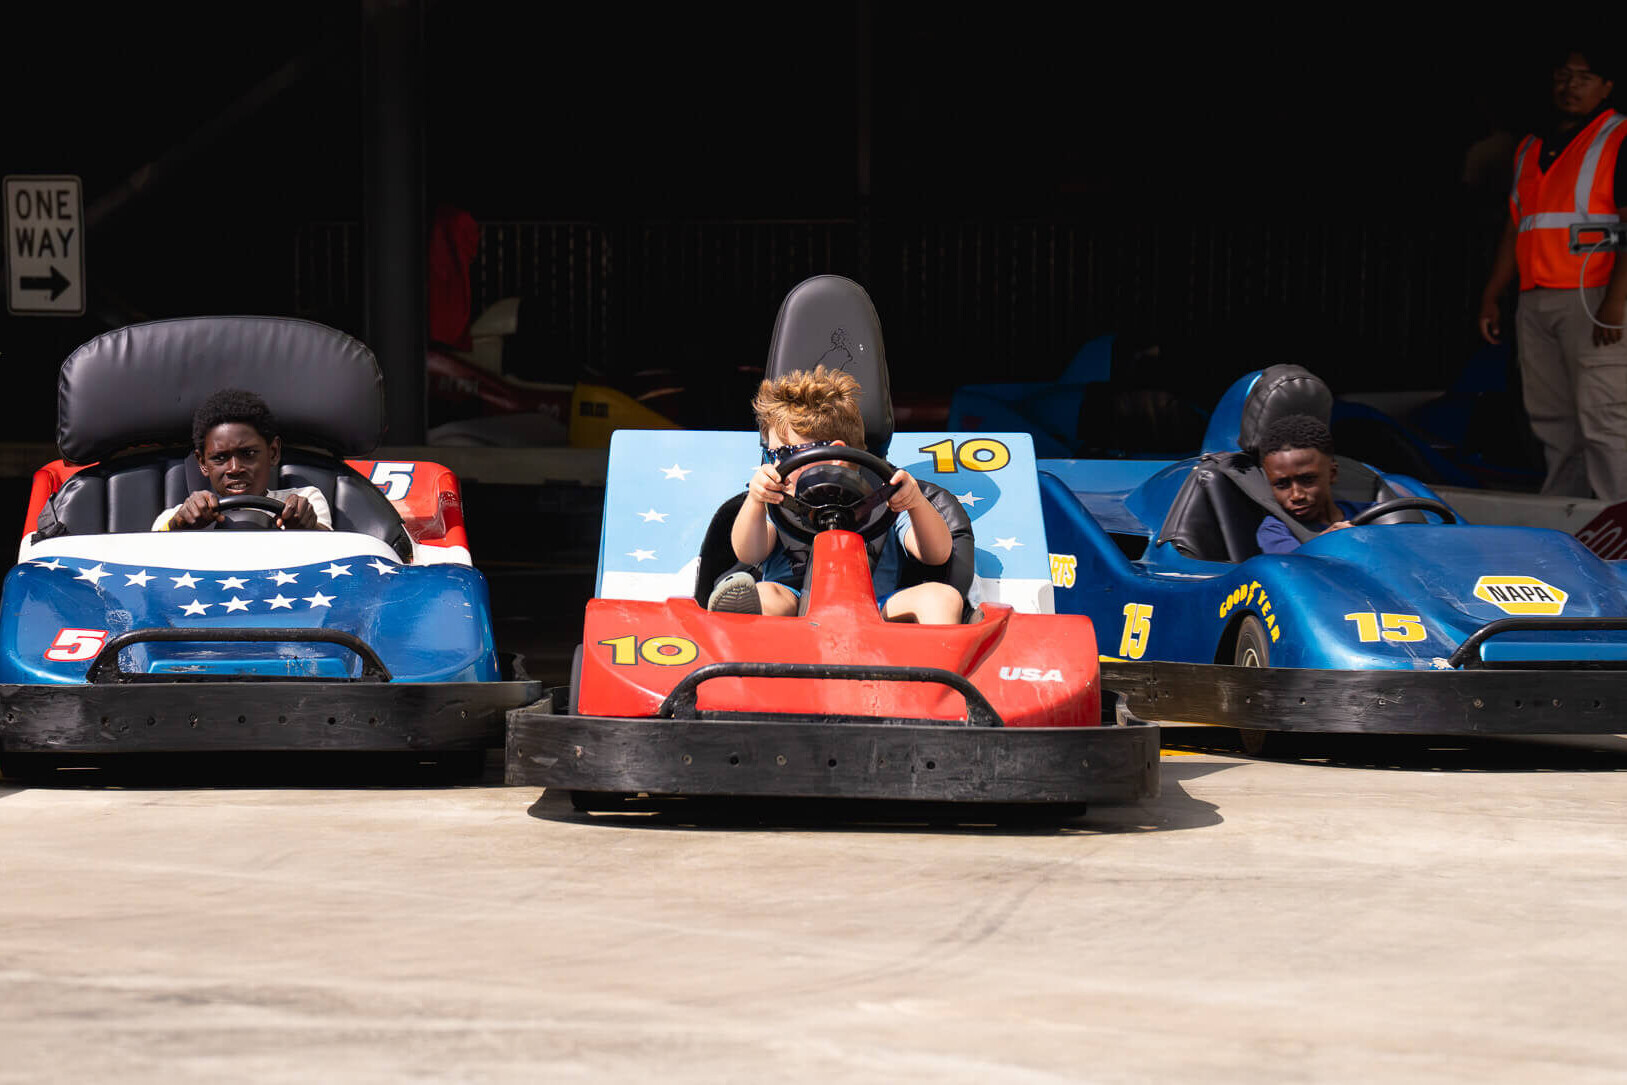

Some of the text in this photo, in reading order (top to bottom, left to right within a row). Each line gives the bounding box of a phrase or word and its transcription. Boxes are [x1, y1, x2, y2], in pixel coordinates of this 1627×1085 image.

[15, 189, 72, 220] ONE
[15, 226, 75, 259] WAY
[919, 438, 1011, 473] 10
[369, 462, 415, 501] 5
[1049, 553, 1077, 588] RTS
[1487, 585, 1554, 602] NAPA
[1119, 603, 1154, 659] 15
[1344, 613, 1427, 643] 15
[43, 628, 109, 662] 5
[598, 634, 699, 666] 10
[999, 666, 1064, 682] USA
